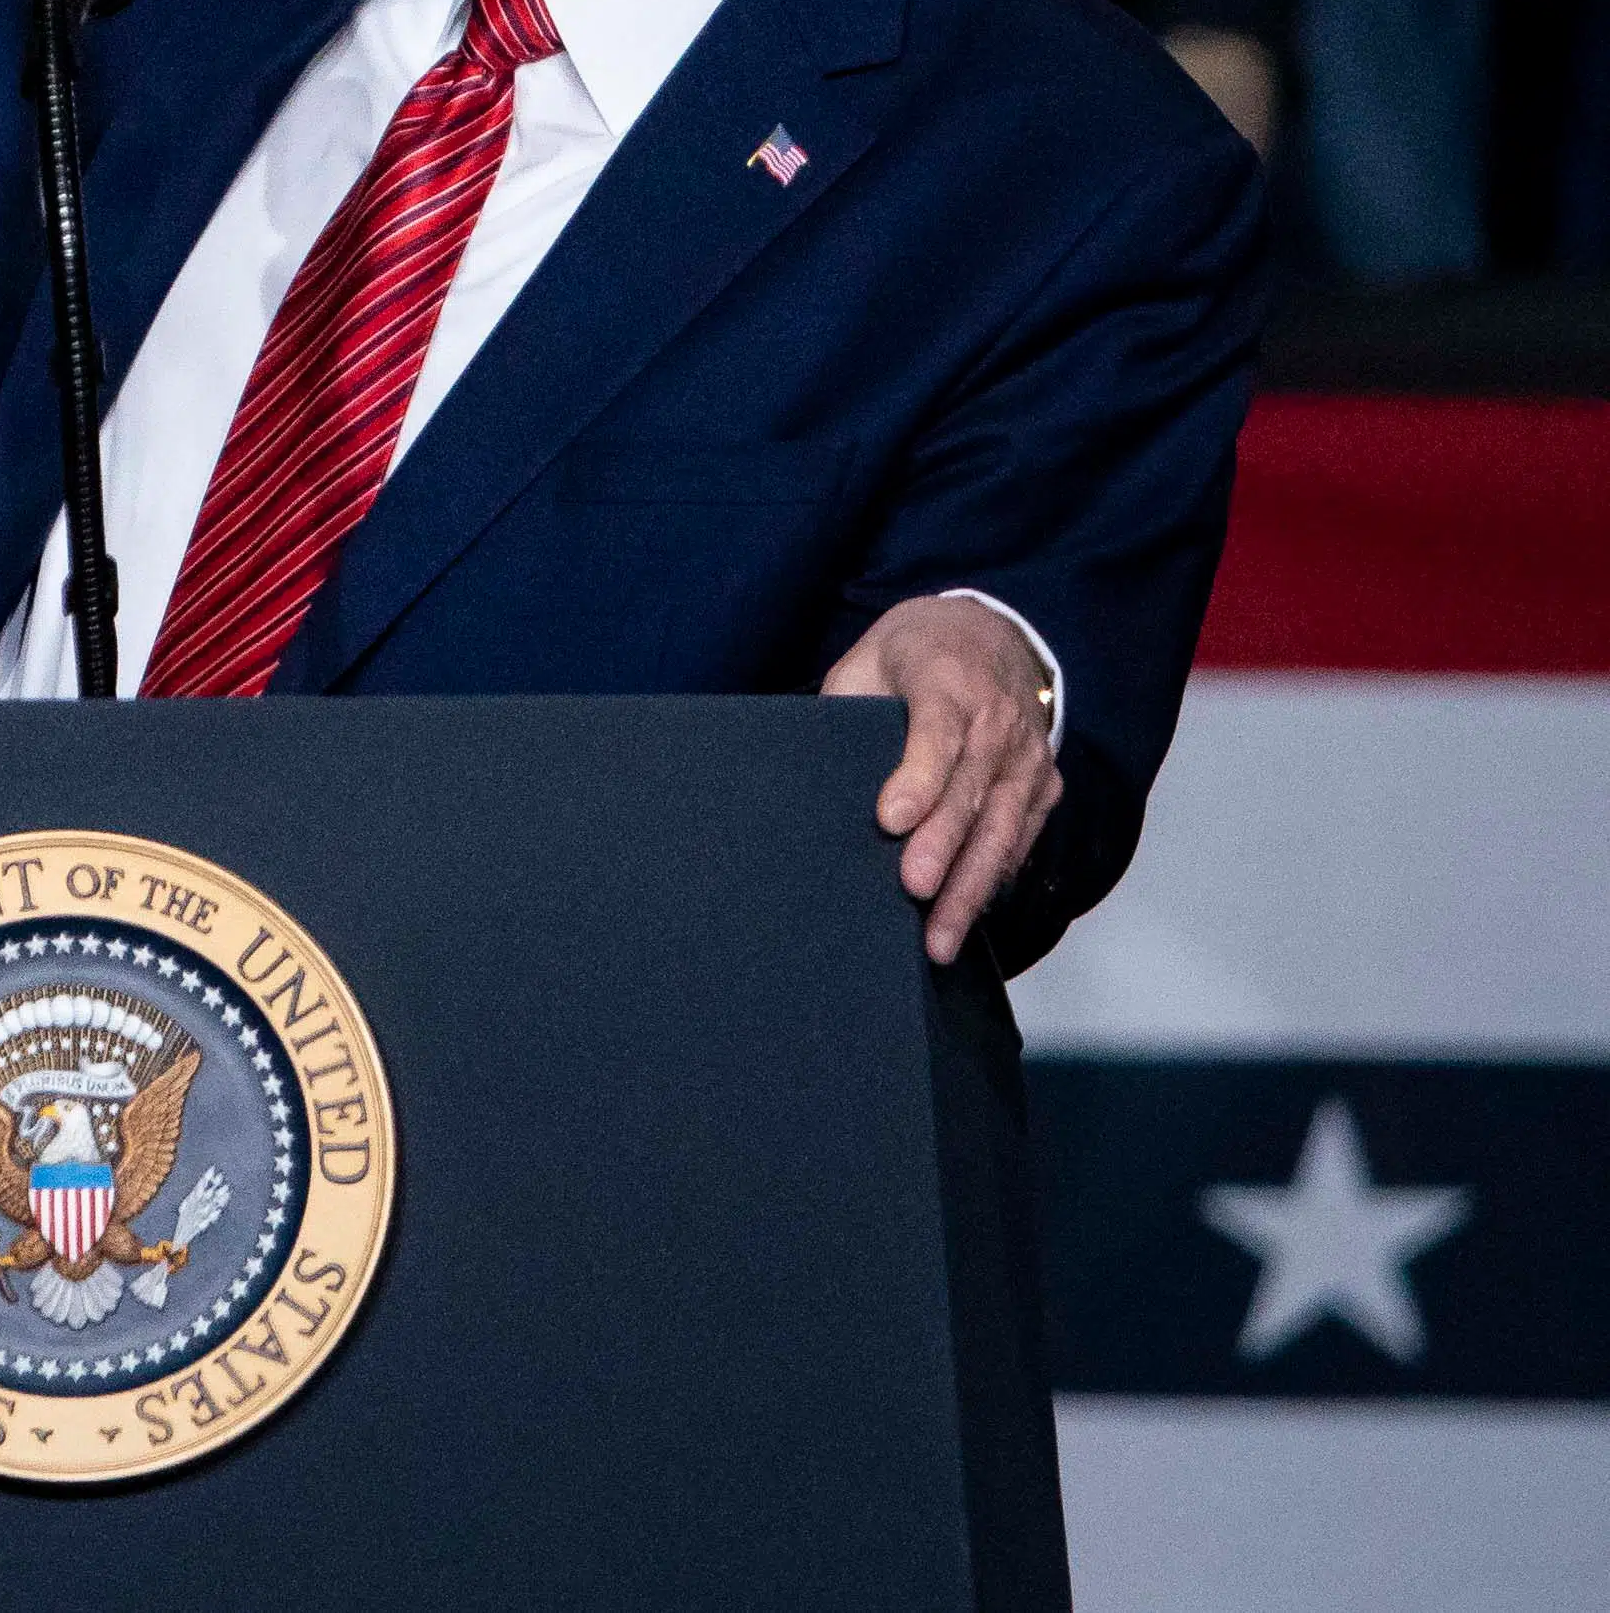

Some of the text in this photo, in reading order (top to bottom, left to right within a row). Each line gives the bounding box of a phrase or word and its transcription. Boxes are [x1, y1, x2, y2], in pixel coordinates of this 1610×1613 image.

[65, 863, 126, 900] OF
[139, 873, 220, 935] THE
[236, 924, 371, 1185] UNITED
[134, 1247, 347, 1447] STATES
